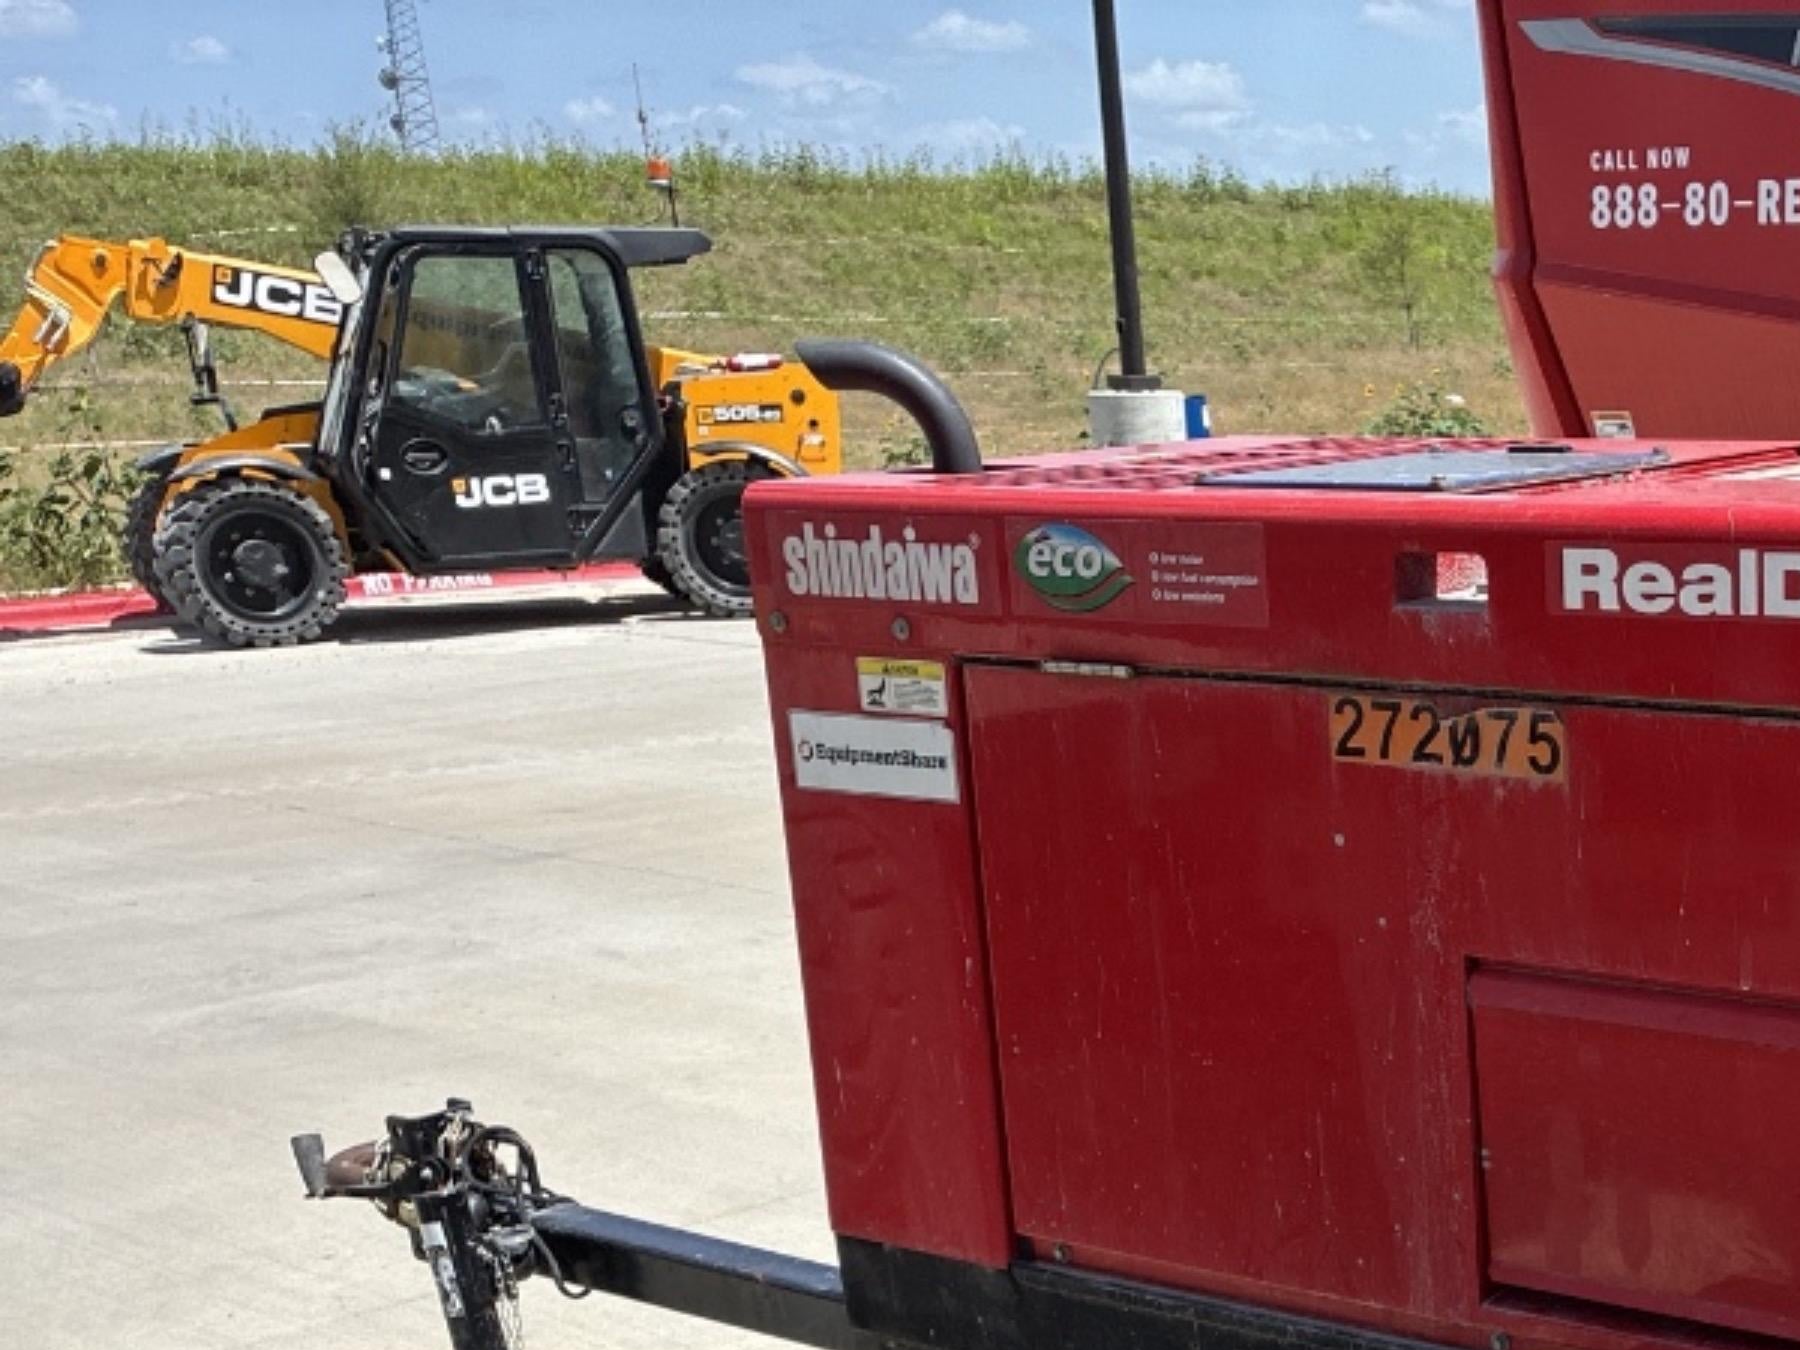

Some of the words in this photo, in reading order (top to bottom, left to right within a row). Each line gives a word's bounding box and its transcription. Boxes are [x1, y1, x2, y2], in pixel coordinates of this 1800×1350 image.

[1590, 150, 1638, 172] CALL
[1646, 147, 1690, 168] NOW
[215, 271, 343, 325] JCB
[455, 472, 550, 508] JCB
[1334, 698, 1561, 775] 272075
[814, 742, 948, 771] EquipmentShare
